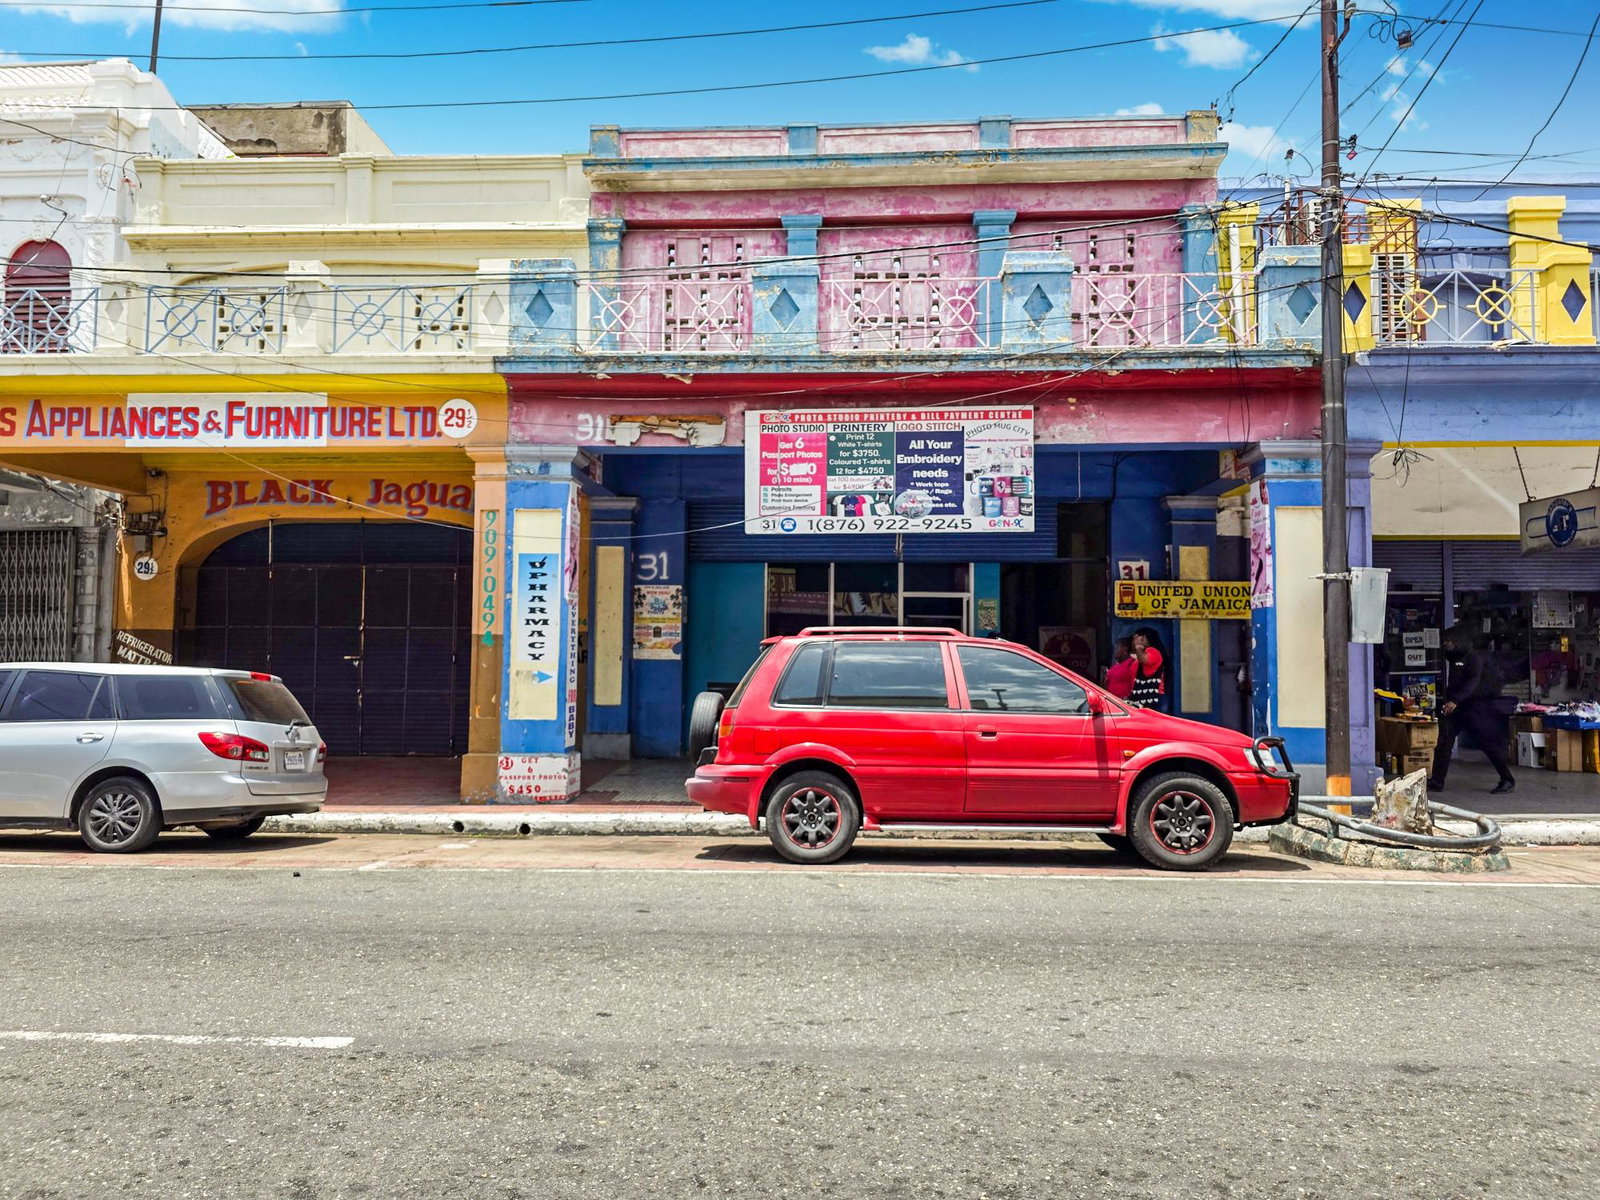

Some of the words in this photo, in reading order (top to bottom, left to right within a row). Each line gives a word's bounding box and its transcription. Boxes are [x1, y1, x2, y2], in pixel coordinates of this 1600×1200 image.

[0, 407, 17, 437] S
[24, 399, 200, 440] APPLIANCES
[202, 410, 223, 433] &
[225, 400, 382, 440] FURNITURE
[387, 406, 443, 439] LTD.
[826, 413, 860, 421] STUDIO
[863, 413, 907, 421] PRINTERY
[920, 412, 940, 420] BILL
[944, 411, 985, 419] PAYMENT
[988, 410, 1023, 419] CENTRE
[576, 413, 603, 441] 31
[761, 424, 791, 433] PHOTO
[793, 424, 825, 432] STUDIO
[833, 423, 888, 432] PRINTERY
[896, 422, 923, 431] LOGO
[926, 422, 961, 430] STITCH
[966, 422, 992, 438] PHOTO
[993, 422, 1012, 430] MUG
[1012, 425, 1031, 437] CITY
[795, 437, 805, 449] 6
[909, 440, 924, 449] All
[926, 440, 953, 449] Your
[762, 451, 795, 459] Passport
[852, 449, 881, 457] $3750.
[829, 458, 861, 466] Coloured
[897, 454, 963, 465] Embroidery
[780, 462, 817, 476] $0
[858, 467, 885, 475] $4750
[913, 468, 949, 478] needs
[204, 479, 337, 517] BLACK
[366, 478, 474, 518] Jagua
[762, 519, 777, 530] 31
[807, 519, 866, 532] 1(876)
[873, 518, 972, 530] 922-9245
[637, 551, 669, 581] 31
[1122, 565, 1145, 580] 31
[1138, 586, 1194, 597] UNITED
[1203, 586, 1252, 597] UNION
[1151, 598, 1171, 610] OF
[1179, 598, 1252, 610] JAMAICA
[524, 572, 550, 661] PHARMACY
[1405, 636, 1422, 644] OPEN
[116, 630, 173, 665] REFRIGERATOR
[117, 644, 158, 665] MATTR
[568, 705, 576, 738] BABY
